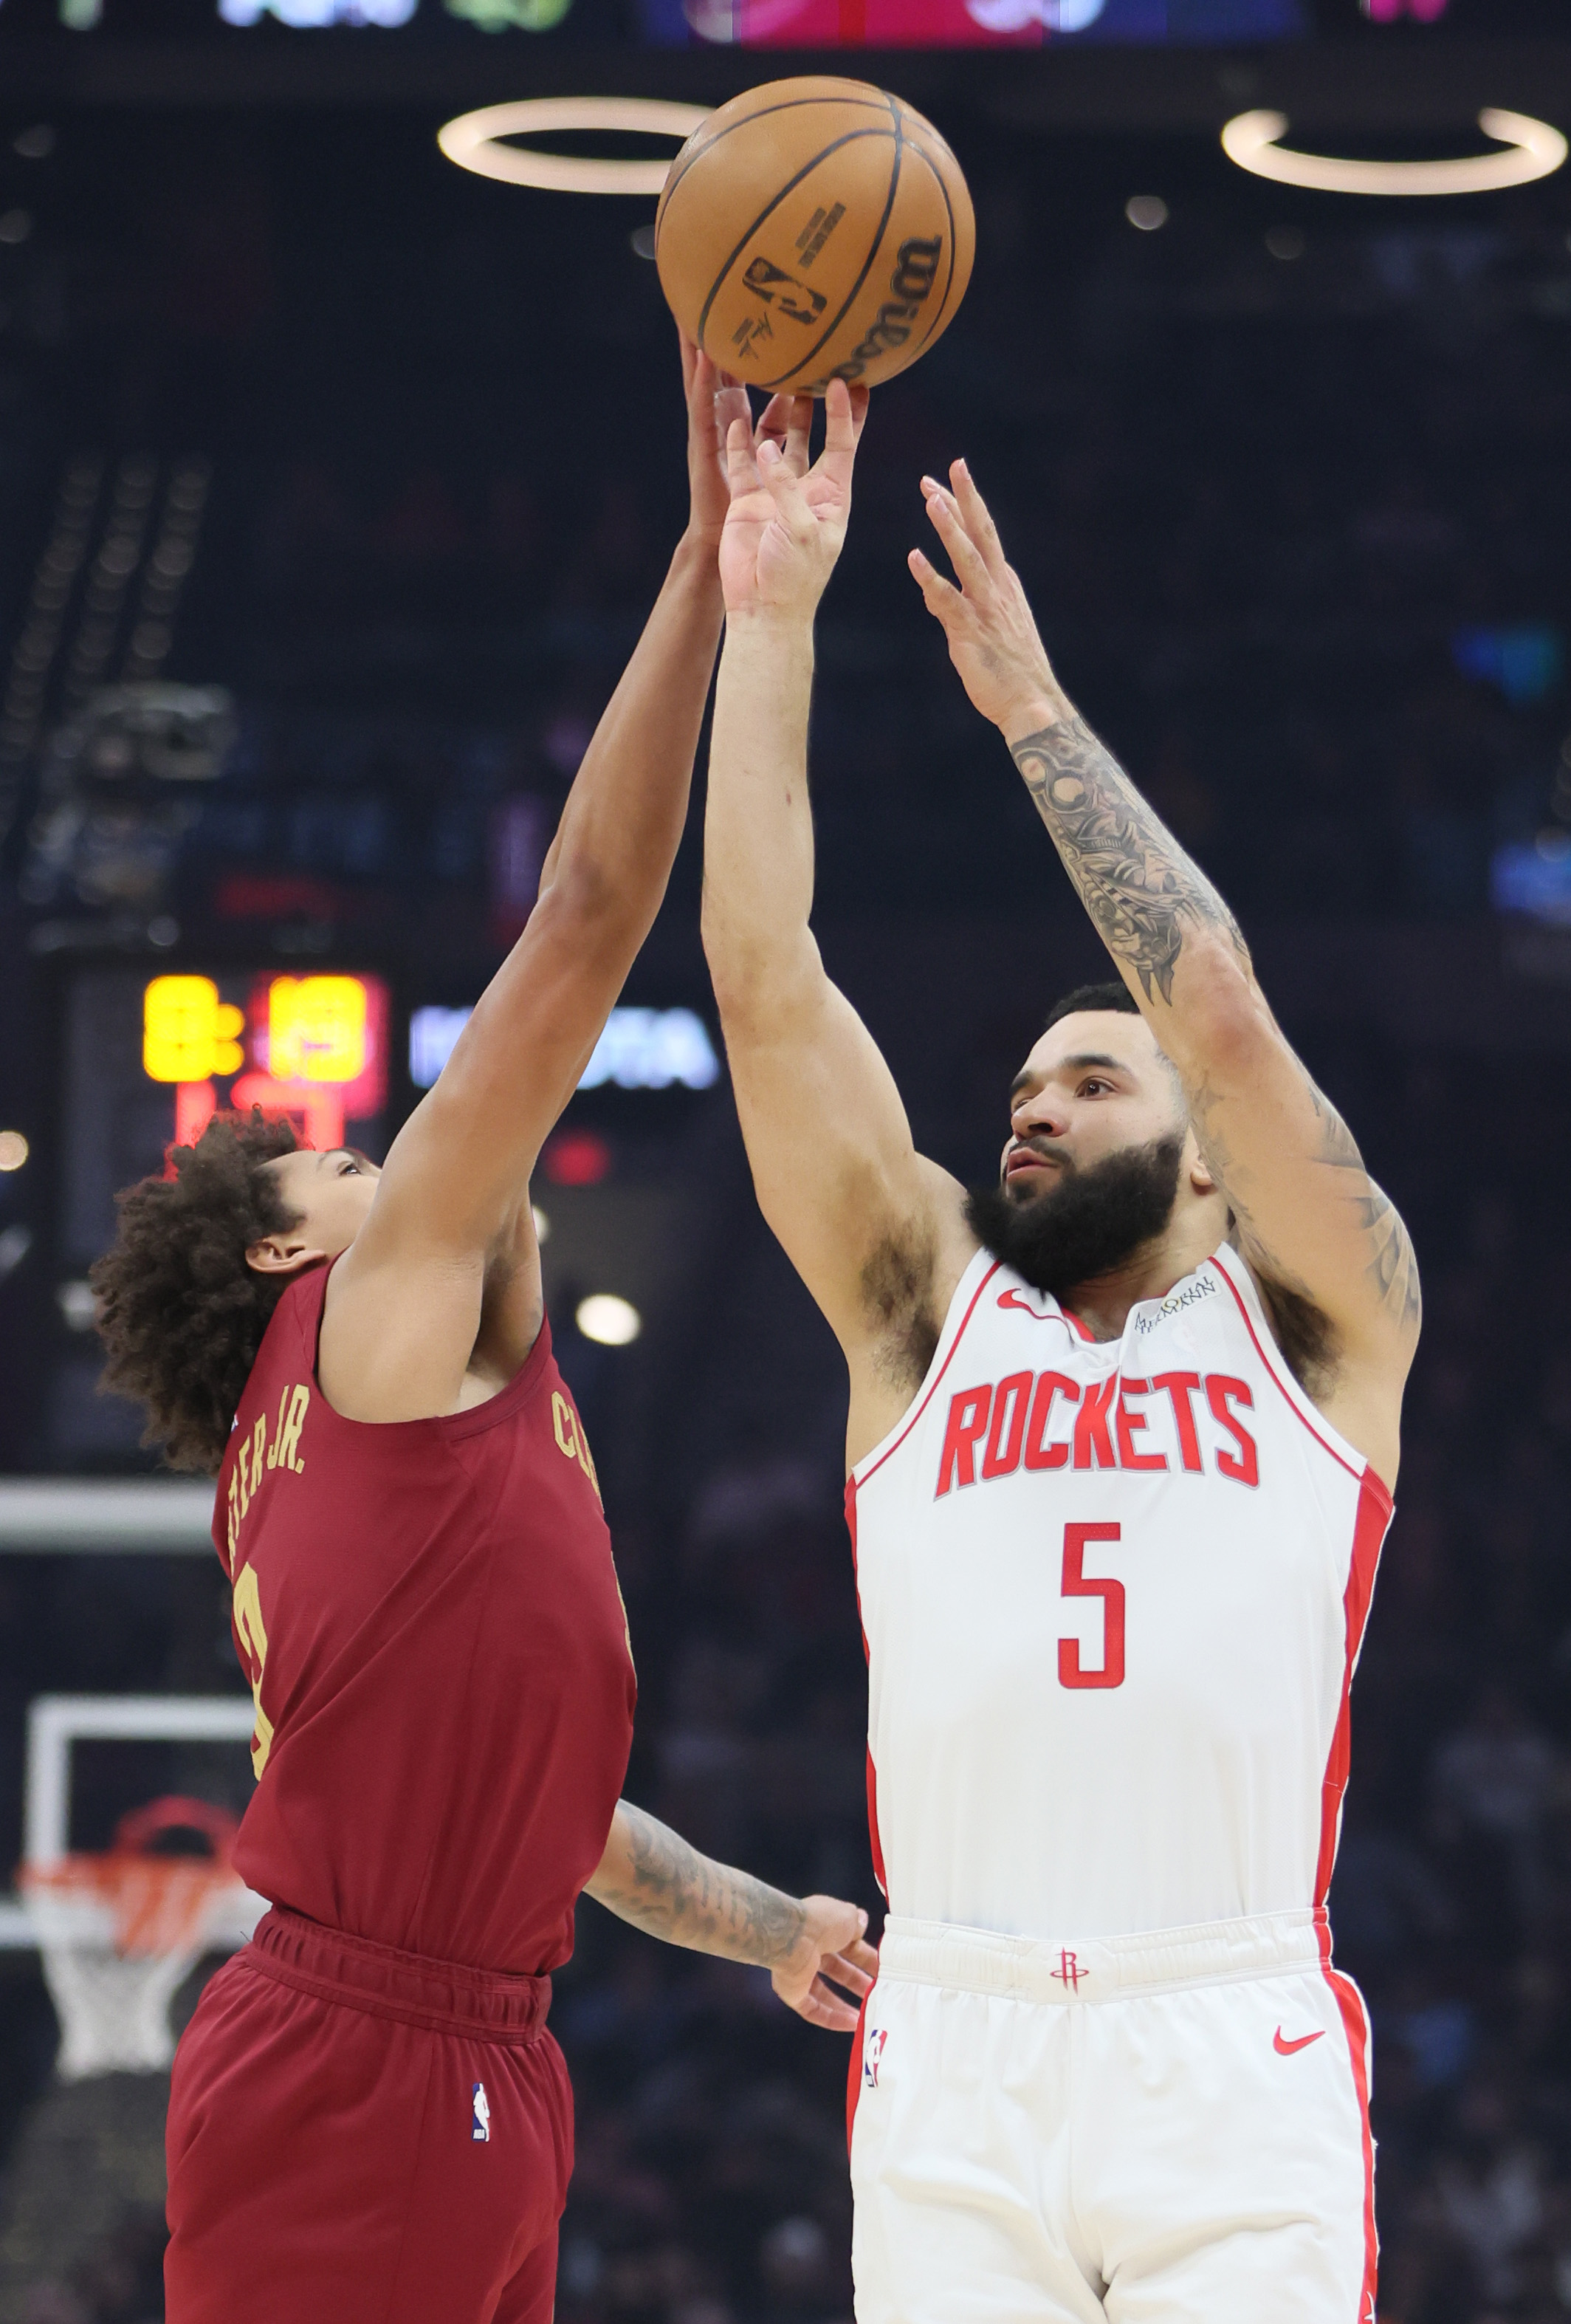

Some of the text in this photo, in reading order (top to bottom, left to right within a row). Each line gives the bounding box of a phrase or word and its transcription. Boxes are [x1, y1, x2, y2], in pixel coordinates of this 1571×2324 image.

[267, 1384, 310, 1474] JR.
[934, 1366, 1260, 1502] ROCKETS
[1058, 1522, 1125, 1690] 5
